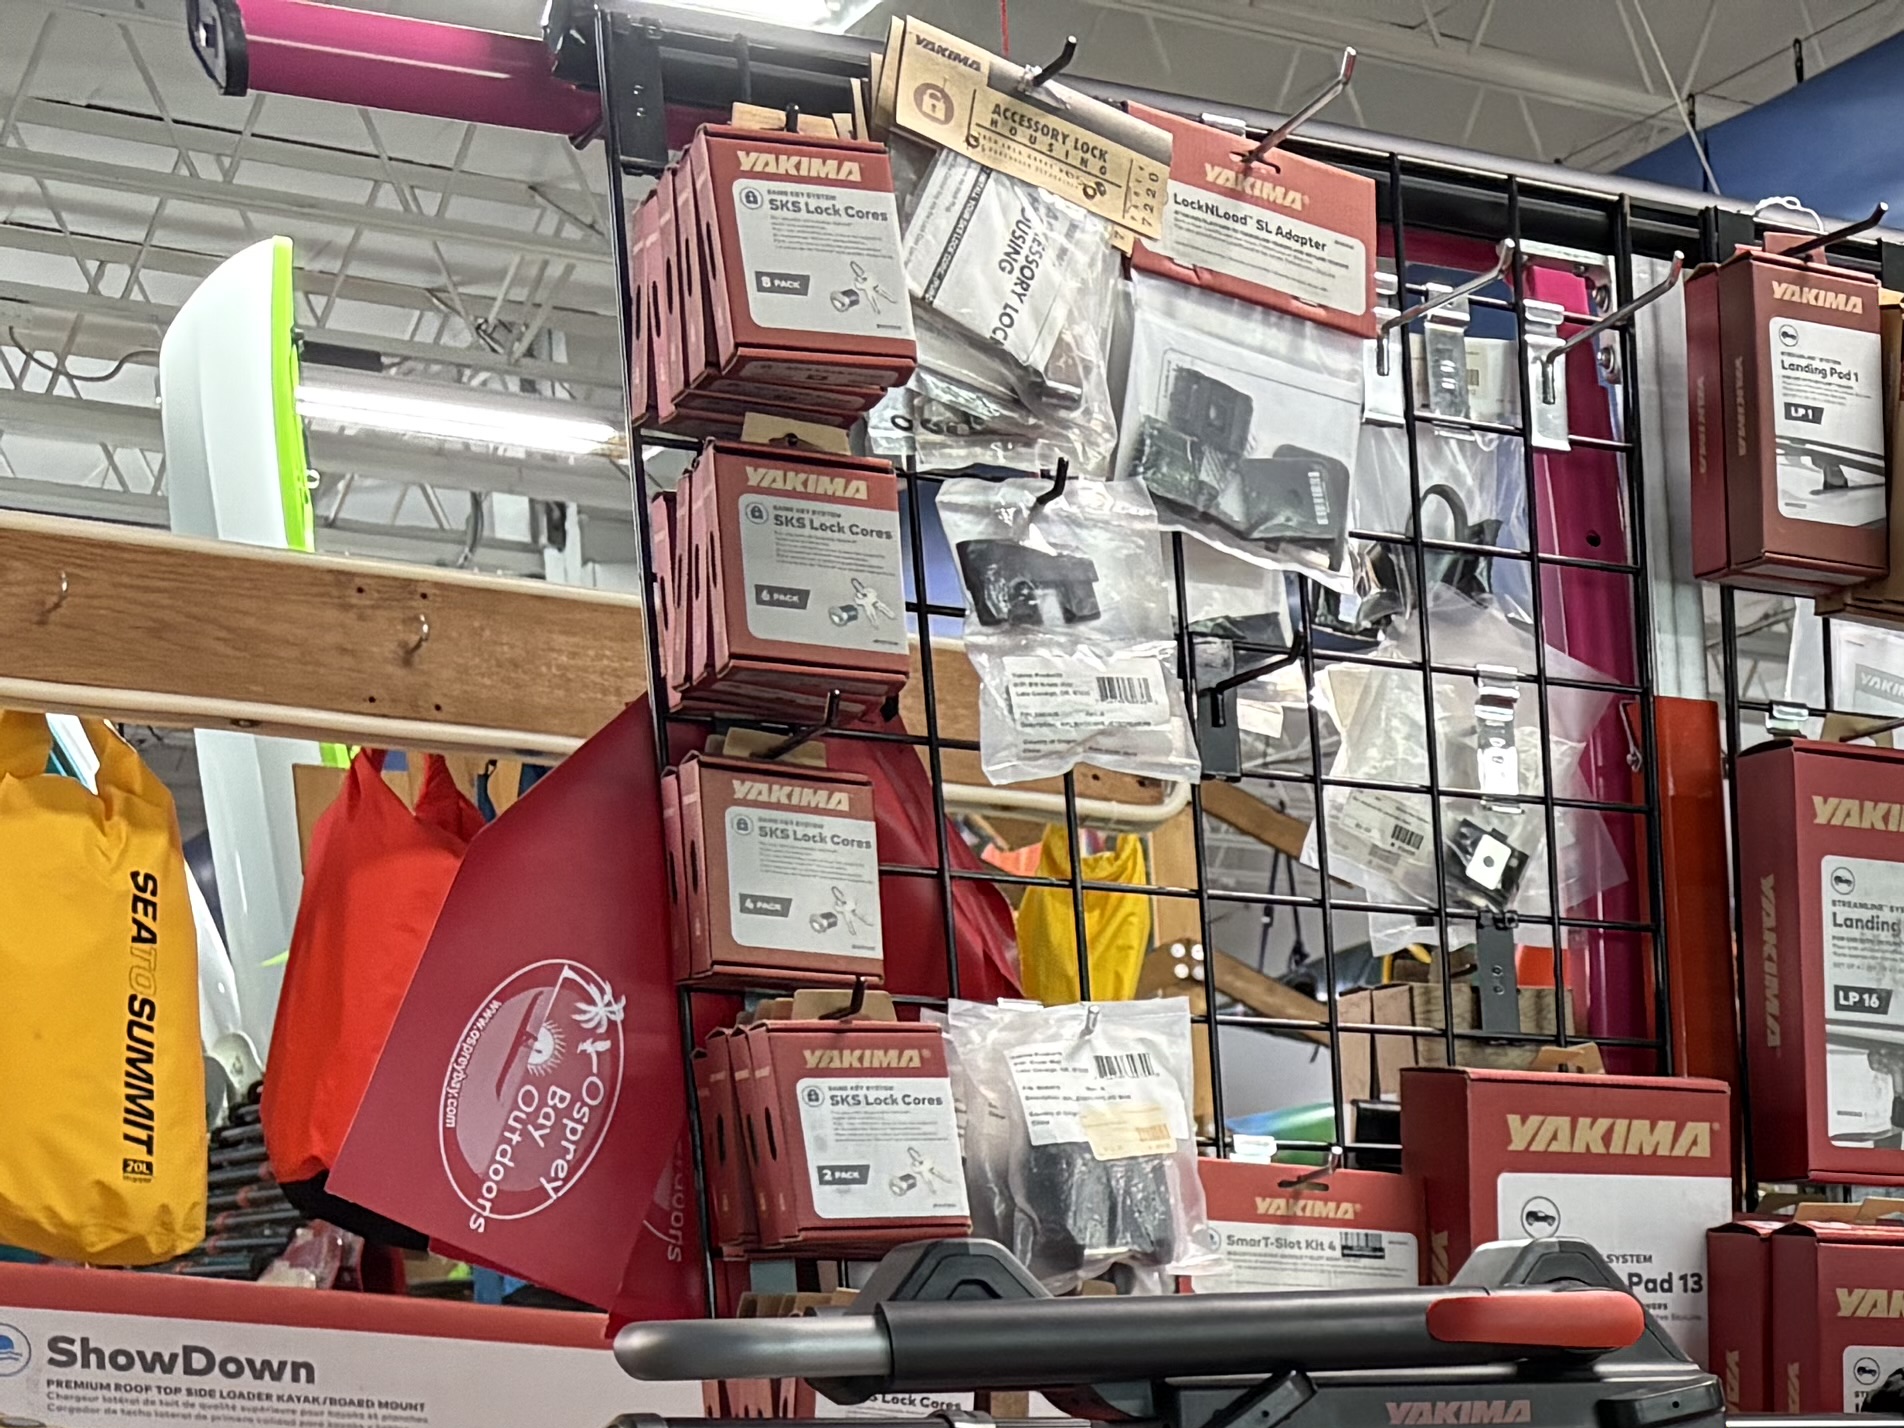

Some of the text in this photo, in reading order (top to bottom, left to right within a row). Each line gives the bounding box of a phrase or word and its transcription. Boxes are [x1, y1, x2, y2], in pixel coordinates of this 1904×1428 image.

[914, 33, 982, 71] YAKIMA
[991, 102, 1109, 164] ACCESSORY LOCK
[737, 151, 862, 182] YAKIMA
[1141, 173, 1160, 227] 7220
[1204, 163, 1305, 210] YAKIMA
[769, 199, 889, 222] SKS Lock Cores
[1255, 218, 1273, 234] SL
[1275, 224, 1327, 253] Adapter
[1832, 912, 1901, 935] Landing
[803, 1048, 922, 1069] YAKIMA
[528, 1084, 571, 1148] Bay
[830, 1092, 943, 1108] SKS Lock Cores
[540, 1076, 604, 1200] Osprey
[1506, 1114, 1712, 1158] YAKIMA
[822, 1169, 860, 1181] 2 PACK
[1628, 1271, 1704, 1295] Pad 13
[46, 1335, 317, 1386] ShowDown
[46, 1379, 112, 1393] PREMIUM
[113, 1382, 151, 1396] ROOF
[154, 1385, 182, 1398] TOP
[185, 1386, 216, 1400] SIDE
[218, 1388, 273, 1403] LOADER
[377, 1398, 426, 1412] MOUNT
